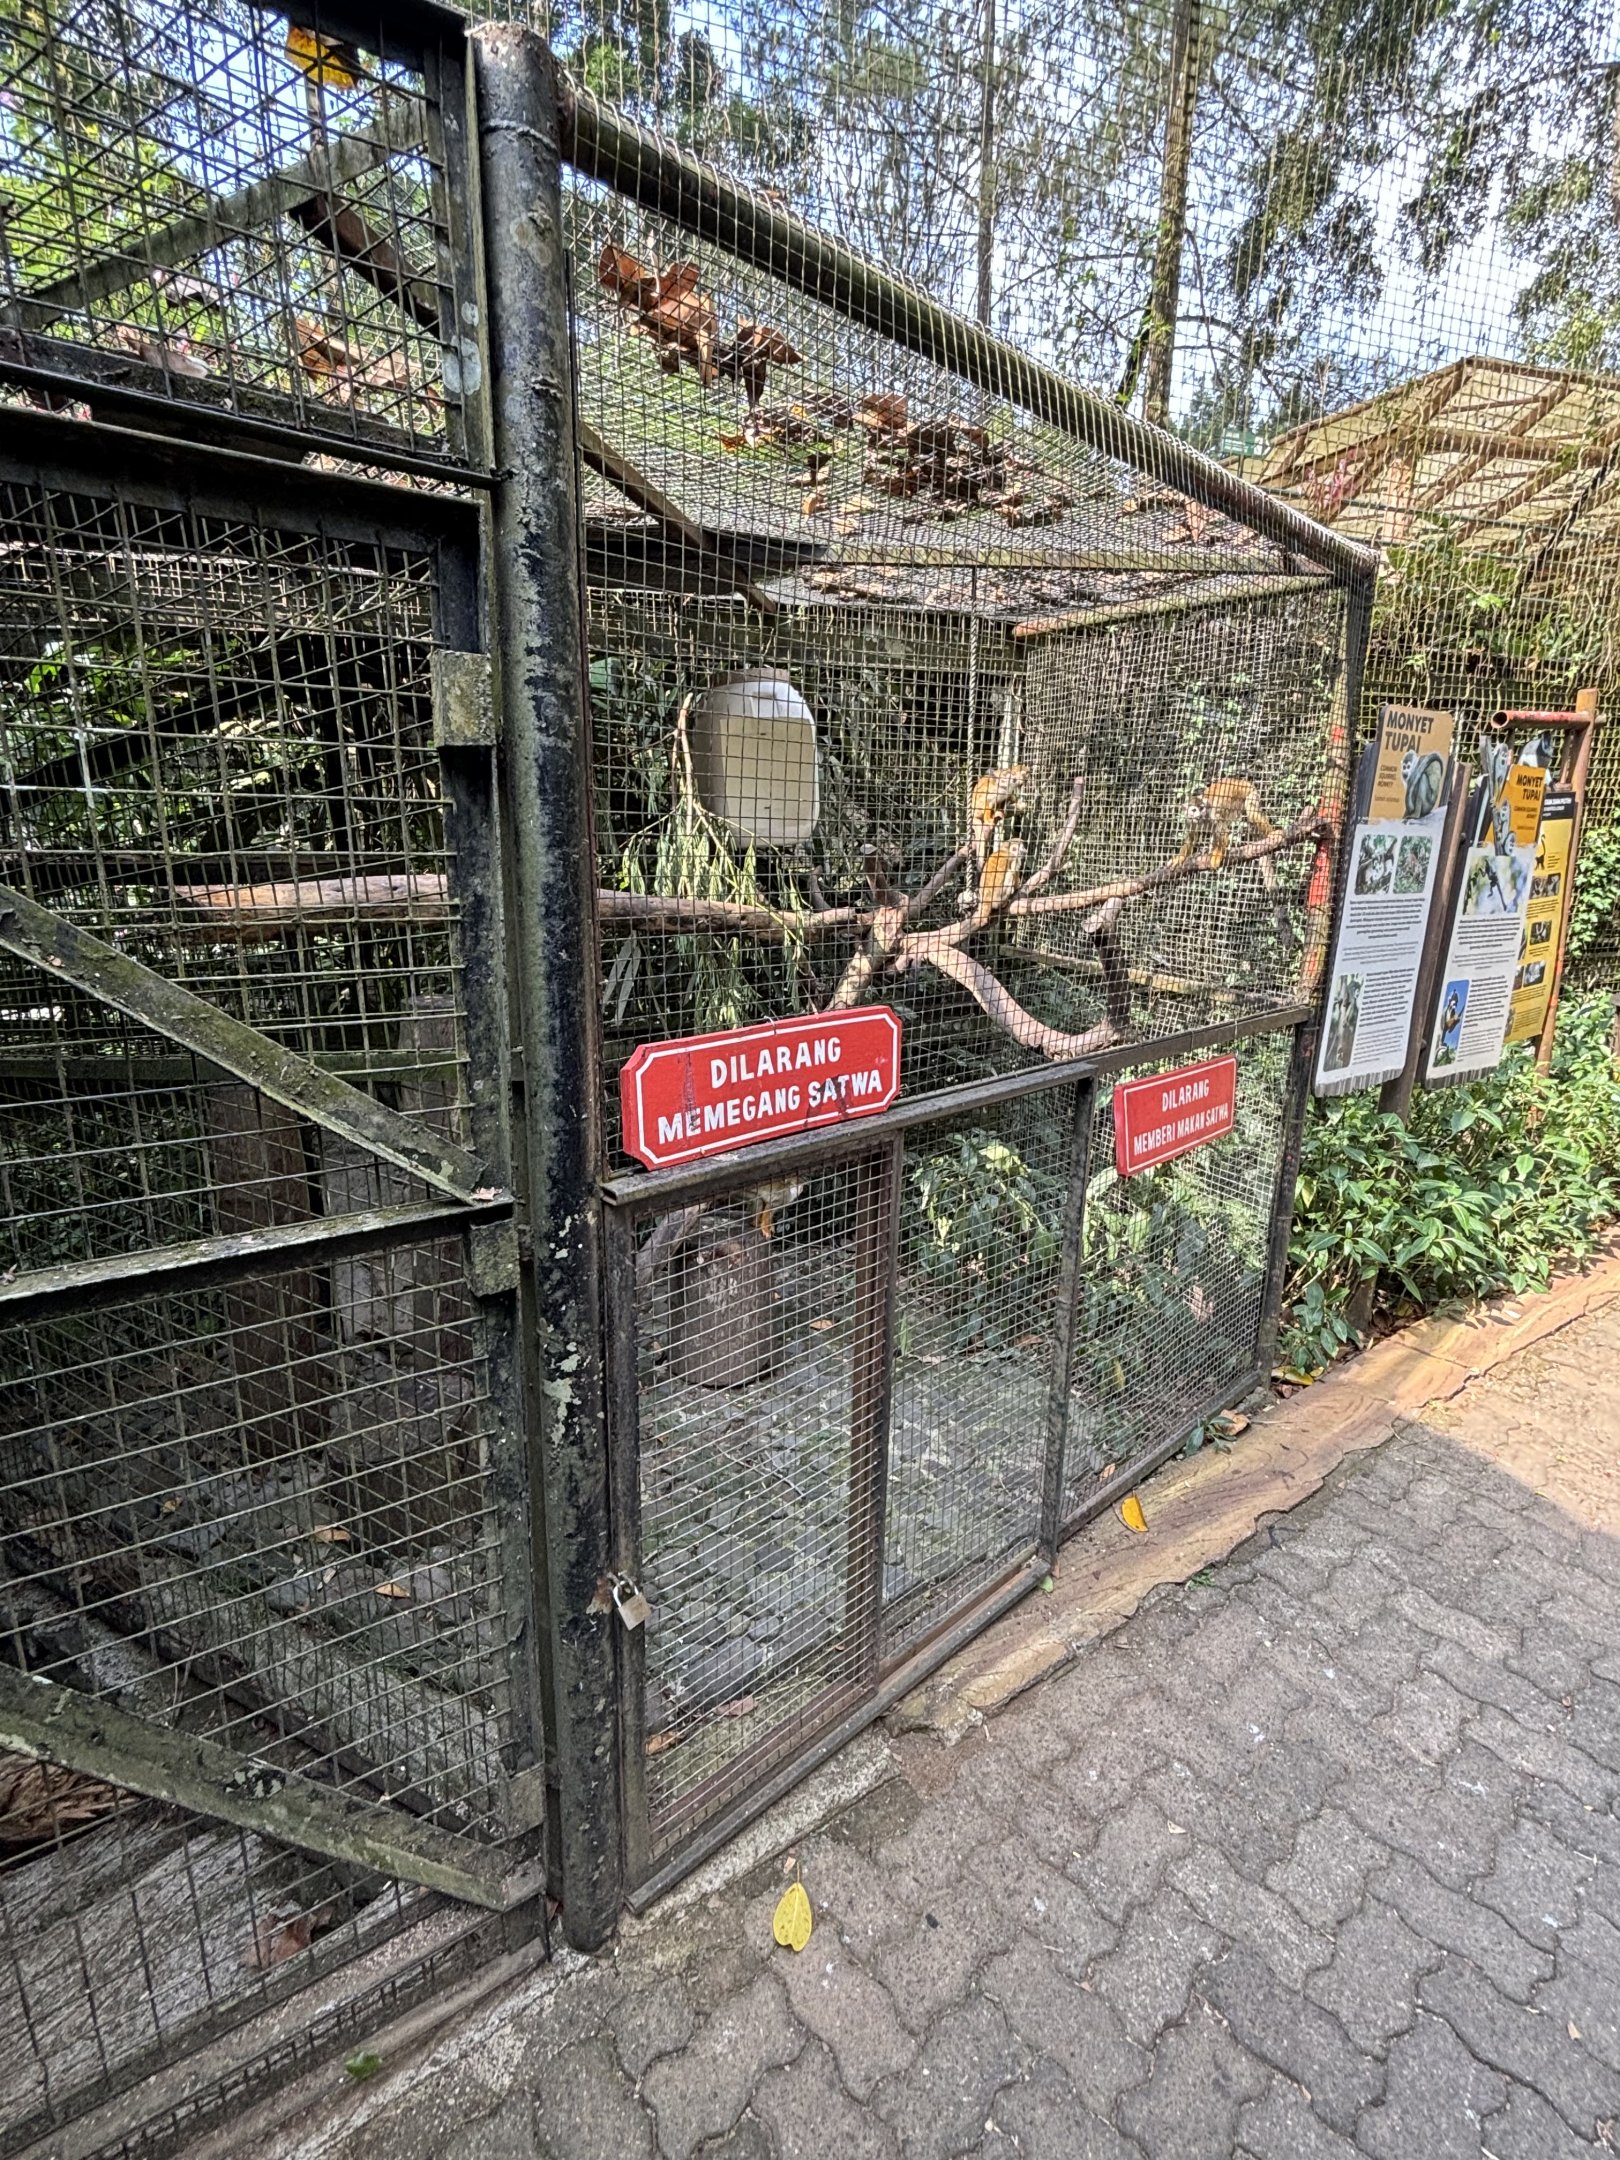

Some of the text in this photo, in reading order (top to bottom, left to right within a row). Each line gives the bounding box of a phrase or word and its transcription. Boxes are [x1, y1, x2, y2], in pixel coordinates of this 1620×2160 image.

[1387, 711, 1434, 734] MONYET
[1385, 731, 1421, 753] TUPAI
[1517, 774, 1544, 787] MONYET
[1522, 788, 1541, 801] TUPAI
[710, 1037, 841, 1089] DILARANG
[657, 1069, 883, 1145] MEMEGANG SATWA
[1161, 1079, 1210, 1112] DILARANG
[1133, 1103, 1229, 1156] MEMBERI MAKAN SATWA
